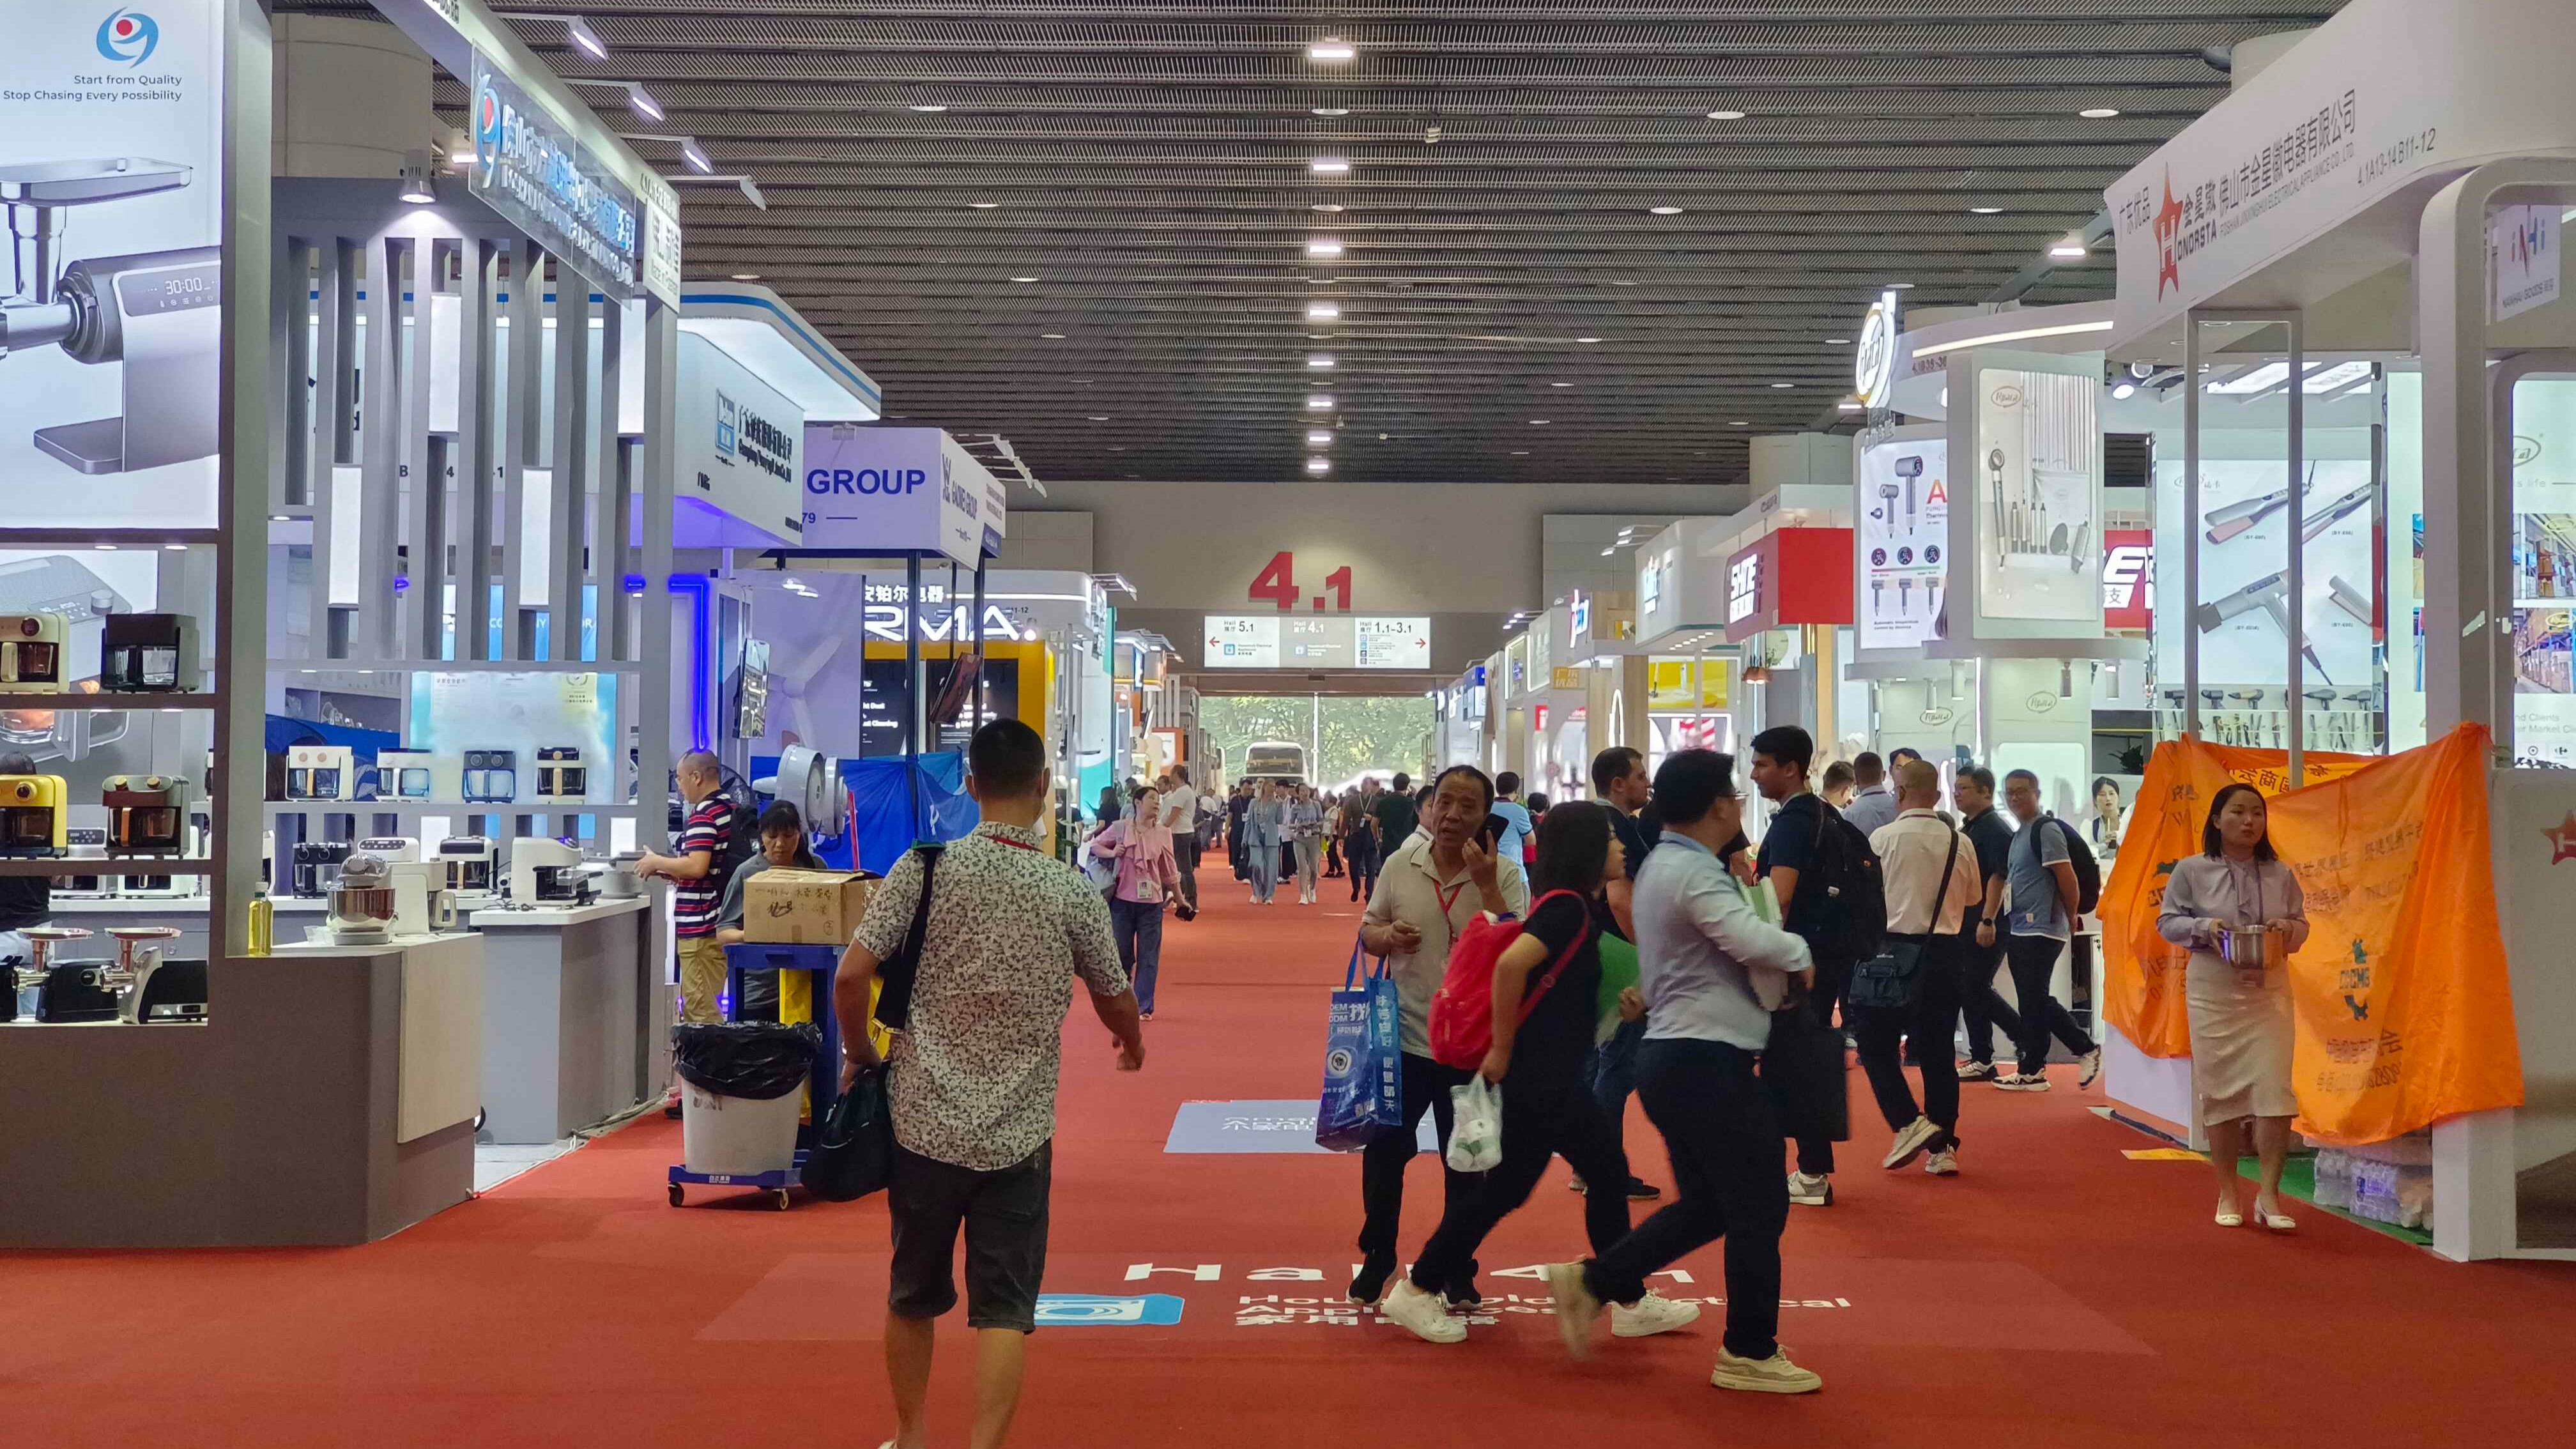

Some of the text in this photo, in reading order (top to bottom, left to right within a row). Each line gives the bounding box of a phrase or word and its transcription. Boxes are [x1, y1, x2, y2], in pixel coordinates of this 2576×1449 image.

[74, 75, 182, 86] Start from Quality
[3, 91, 182, 102] Stop Chasing Every Possibility
[165, 277, 203, 295] 30:00
[807, 469, 926, 494] GROUP
[1249, 552, 1351, 613] 4.1
[1239, 621, 1254, 632] 5.1
[1308, 621, 1324, 633] 4.1
[1375, 622, 1411, 633] 1.1-3.1
[2529, 713, 2559, 722] Clients
[1329, 1013, 1348, 1022] ODM
